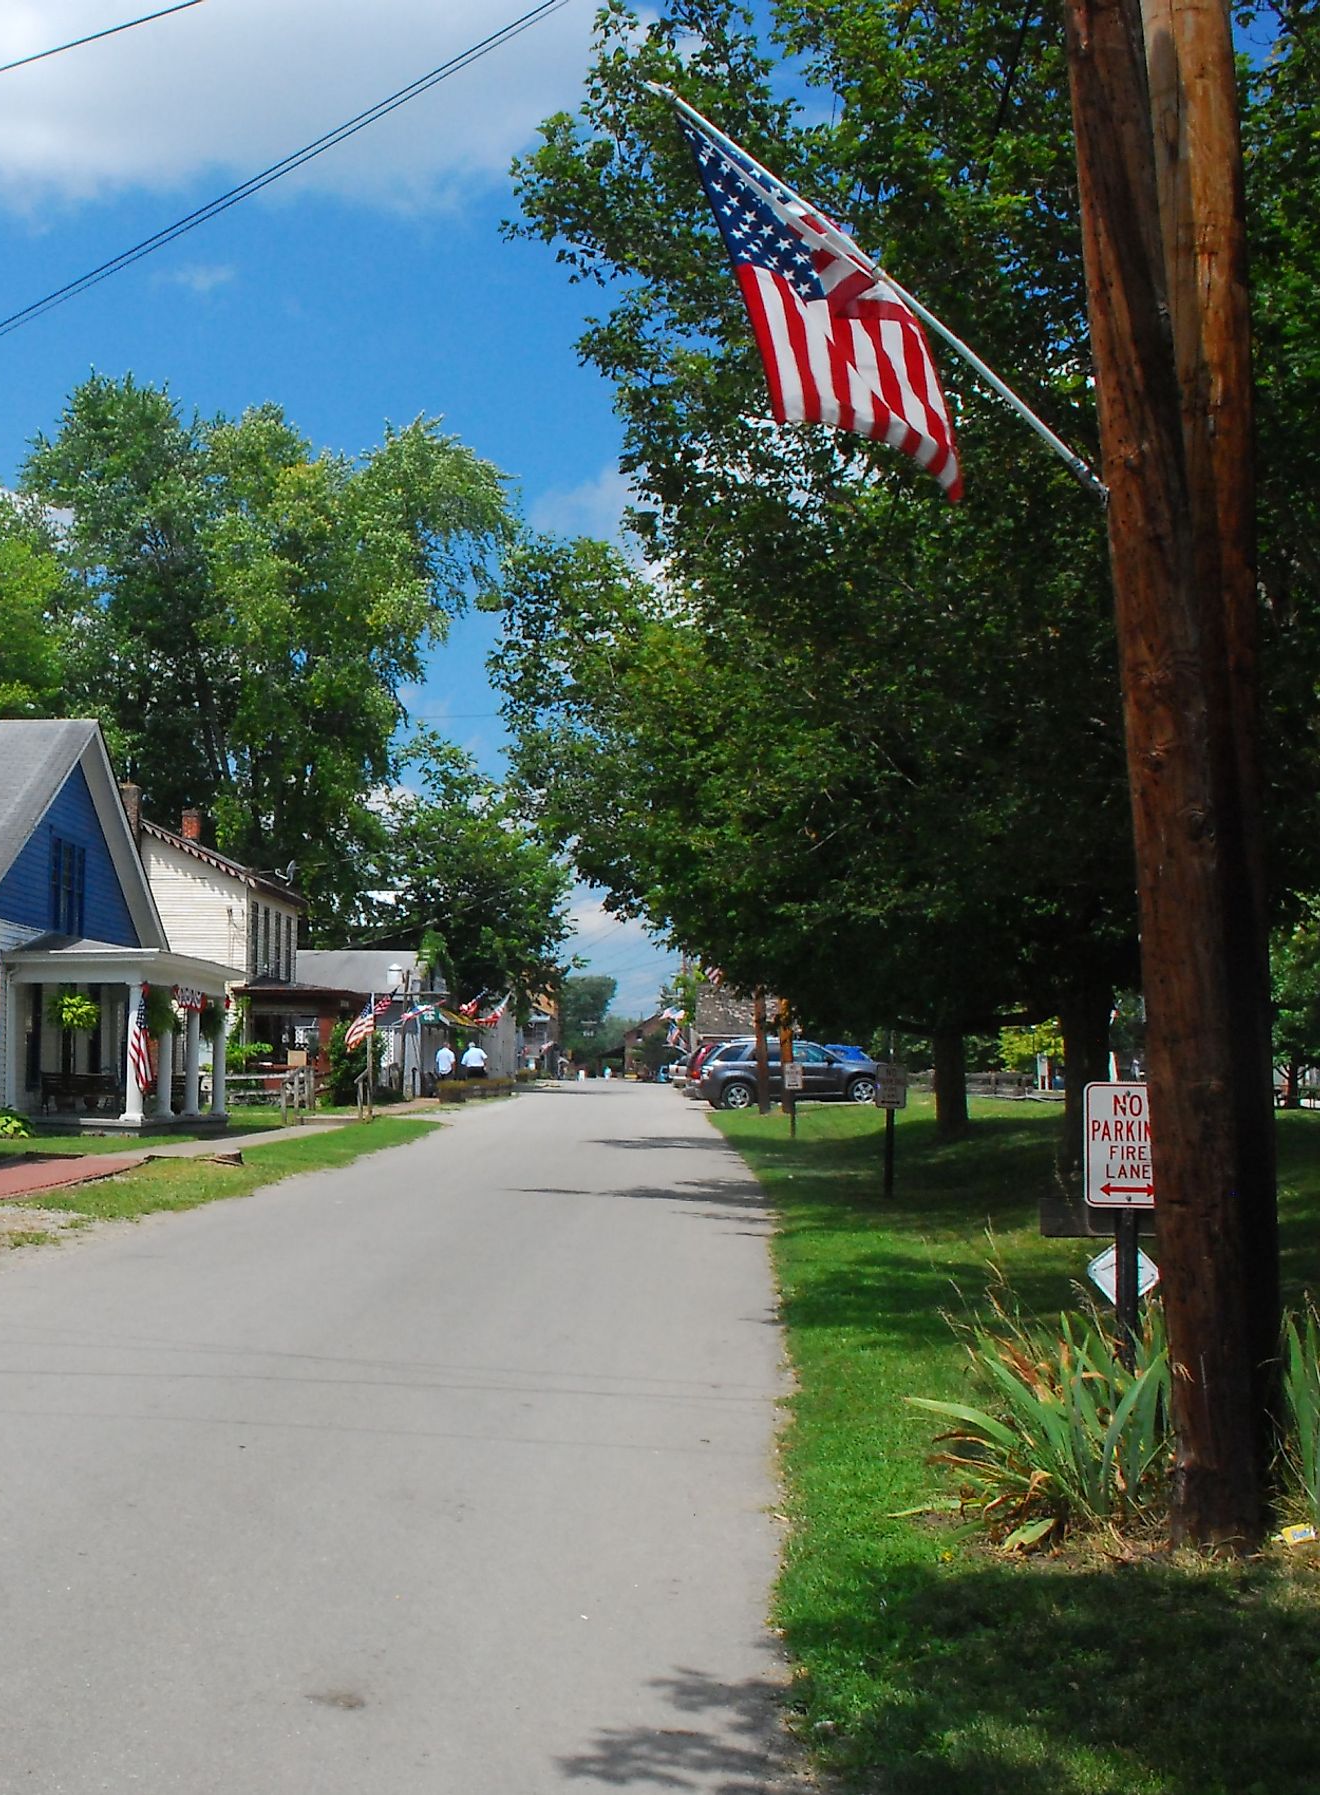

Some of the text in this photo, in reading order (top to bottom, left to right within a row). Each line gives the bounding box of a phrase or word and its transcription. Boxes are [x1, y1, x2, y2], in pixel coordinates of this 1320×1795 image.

[1113, 1094, 1142, 1117] NO
[1091, 1120, 1152, 1142] PARKIN
[1109, 1145, 1147, 1160] FIRE
[1106, 1163, 1151, 1179] LANE
